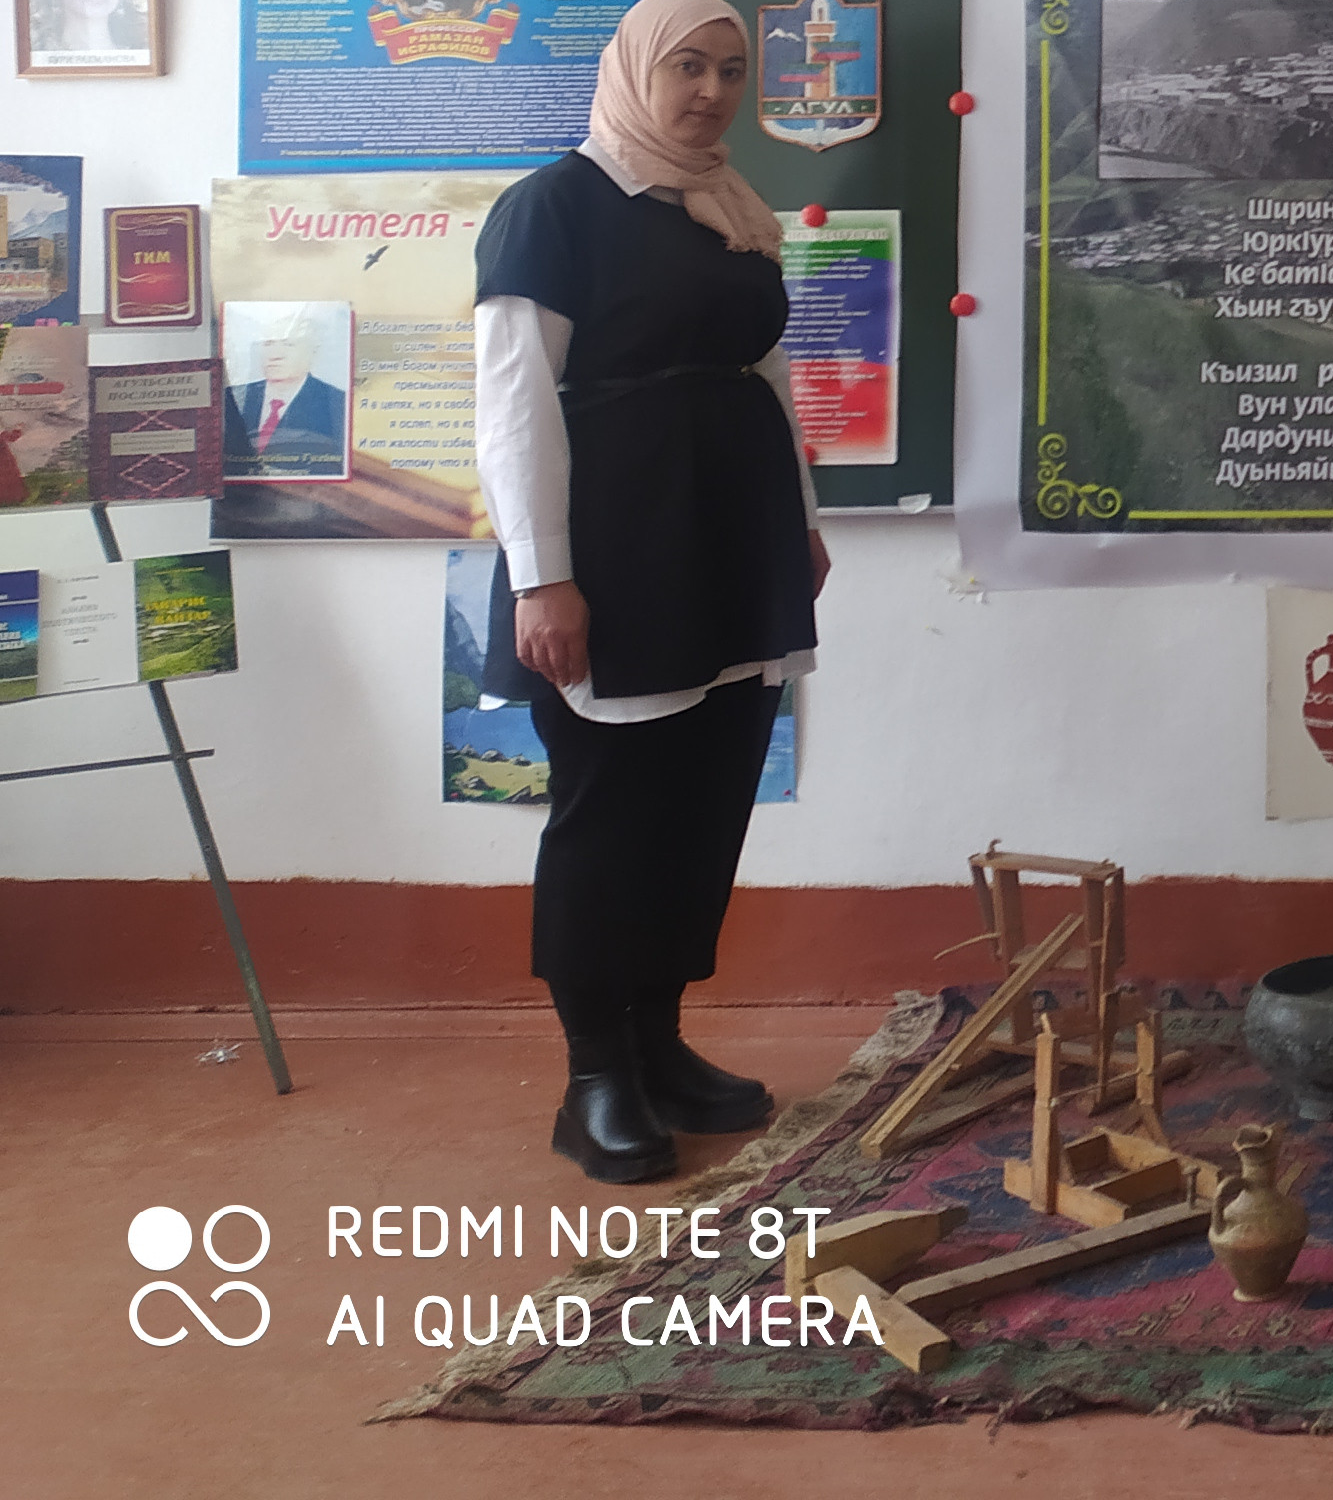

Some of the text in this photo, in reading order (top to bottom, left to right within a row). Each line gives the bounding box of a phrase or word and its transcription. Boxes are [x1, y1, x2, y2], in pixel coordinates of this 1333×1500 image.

[408, 34, 484, 44] РАМАЗАН
[789, 102, 853, 114] АГУЛ
[266, 206, 449, 240] Учителя
[1225, 265, 1255, 284] Ке
[1214, 297, 1281, 318] Хьин
[1201, 362, 1297, 384] Къизил
[1239, 394, 1286, 419] Вун
